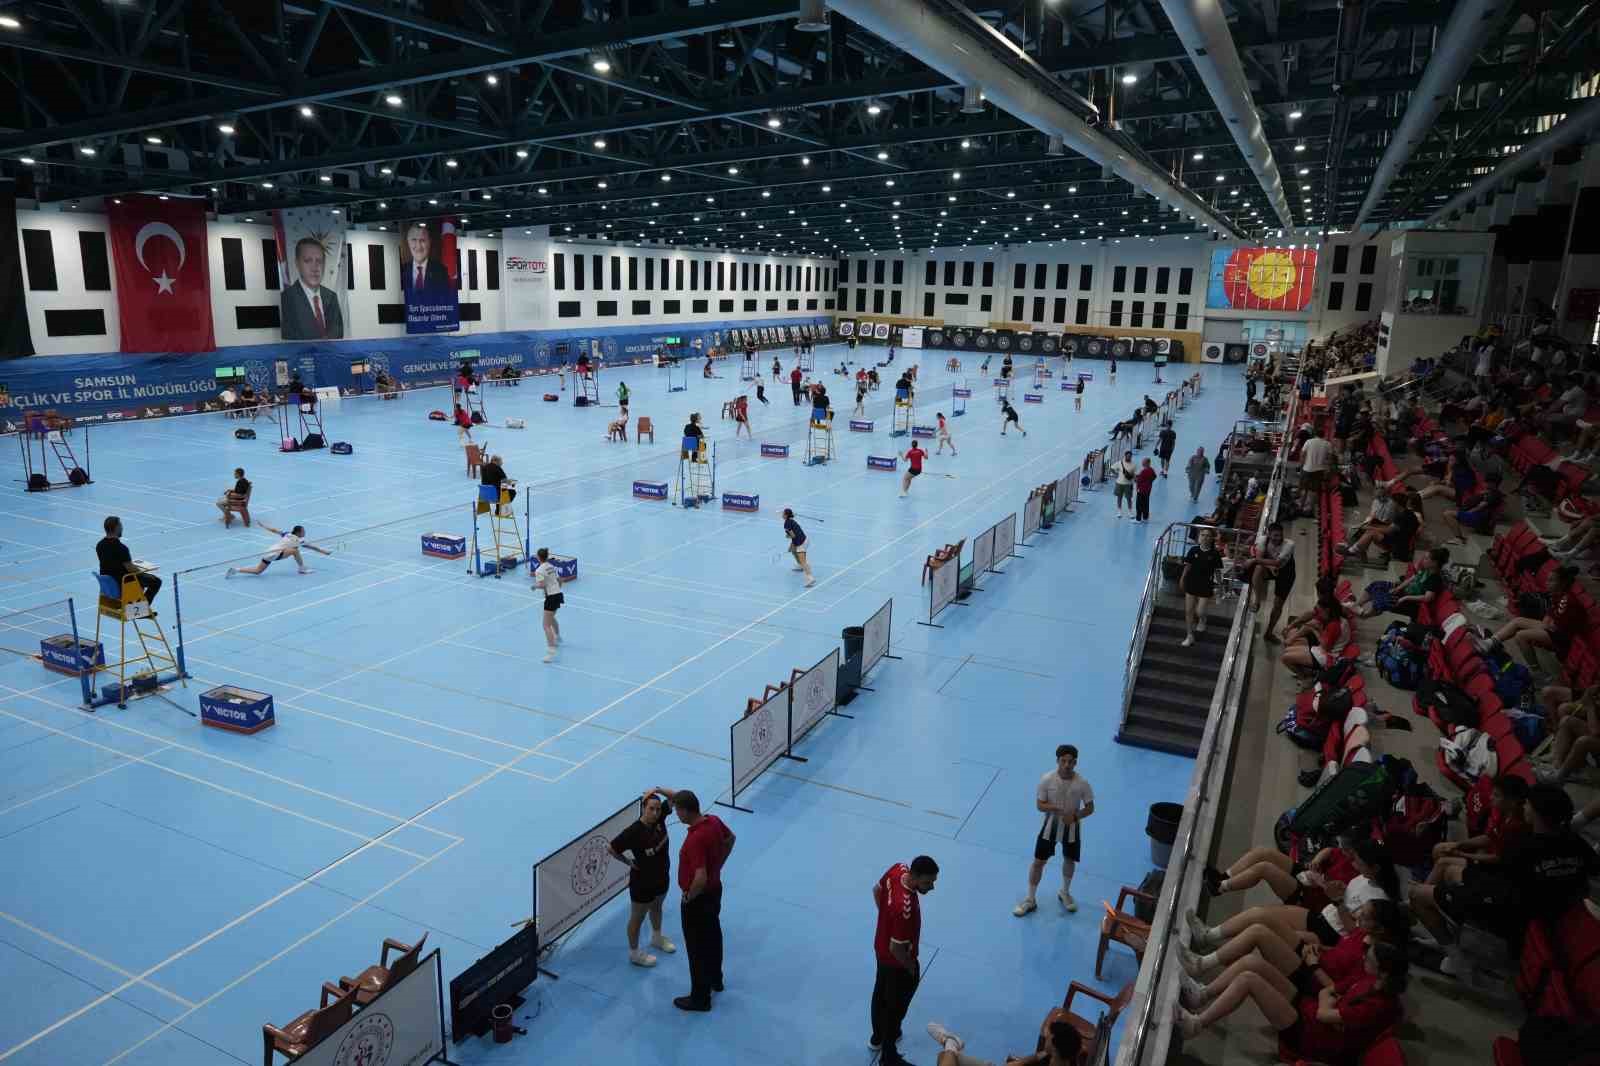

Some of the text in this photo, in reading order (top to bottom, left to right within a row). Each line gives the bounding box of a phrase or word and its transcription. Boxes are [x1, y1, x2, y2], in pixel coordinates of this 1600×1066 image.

[74, 375, 136, 389] SAMSUN
[52, 392, 72, 404] VE
[74, 390, 113, 402] SPOR
[119, 386, 131, 400] İL
[134, 378, 217, 398] MÜDÜRLÜĞÜ
[212, 705, 248, 720] VICTOR
